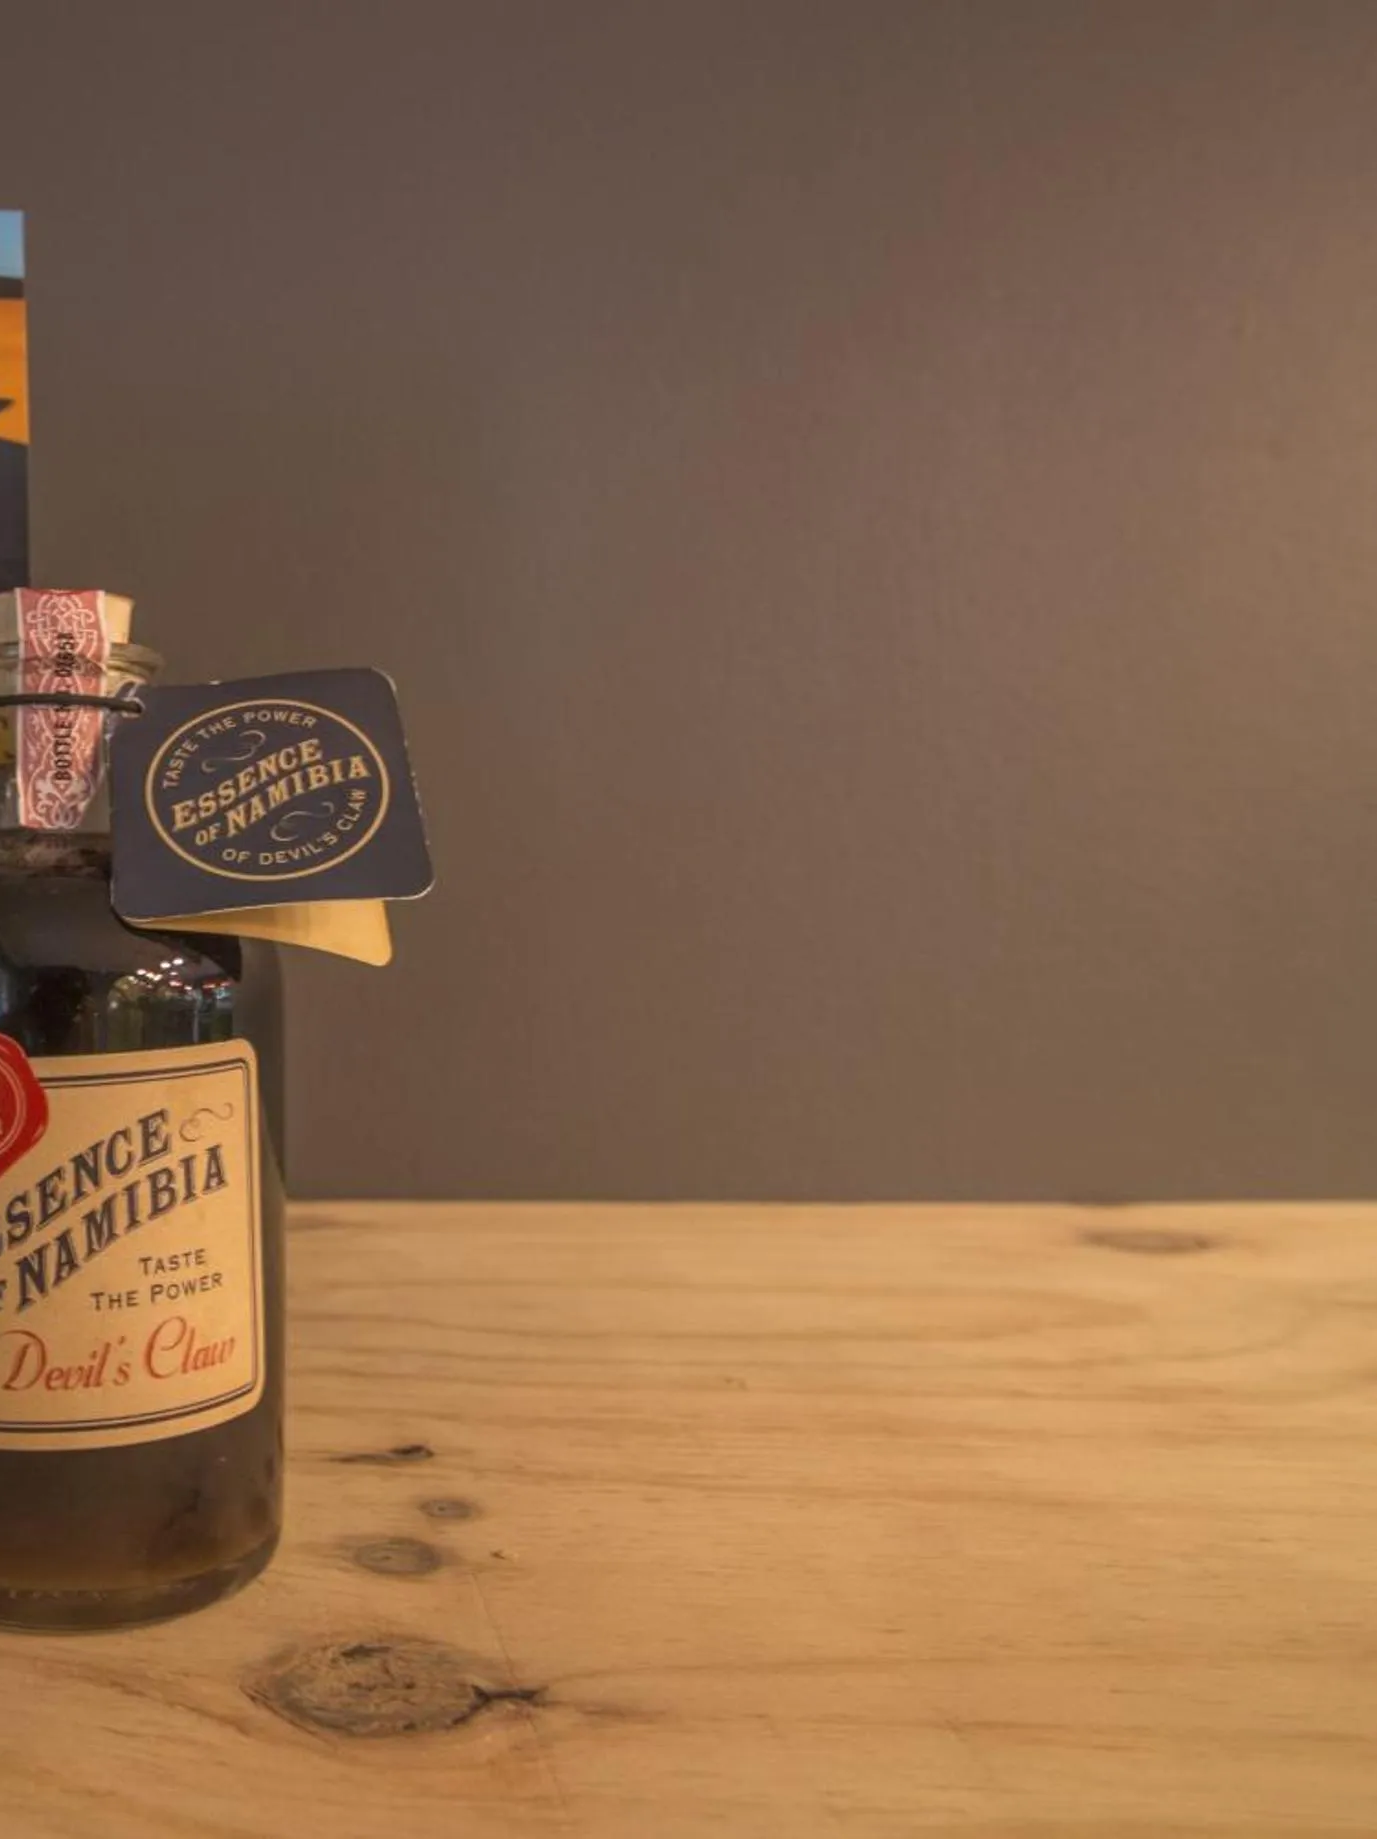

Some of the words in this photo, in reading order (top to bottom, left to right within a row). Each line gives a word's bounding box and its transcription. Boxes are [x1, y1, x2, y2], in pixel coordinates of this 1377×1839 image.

[162, 740, 199, 789] TASTE
[198, 716, 236, 739] THE
[243, 709, 318, 729] POWER
[171, 738, 324, 832] ESSENCE
[195, 823, 222, 847] OF
[226, 754, 371, 838] NAMIBIA
[222, 848, 251, 863] OF
[259, 832, 339, 865] DEVIL'S
[337, 788, 368, 831] CLAW
[15, 1144, 229, 1311] NAMIBIA
[143, 1315, 236, 1381] Claw
